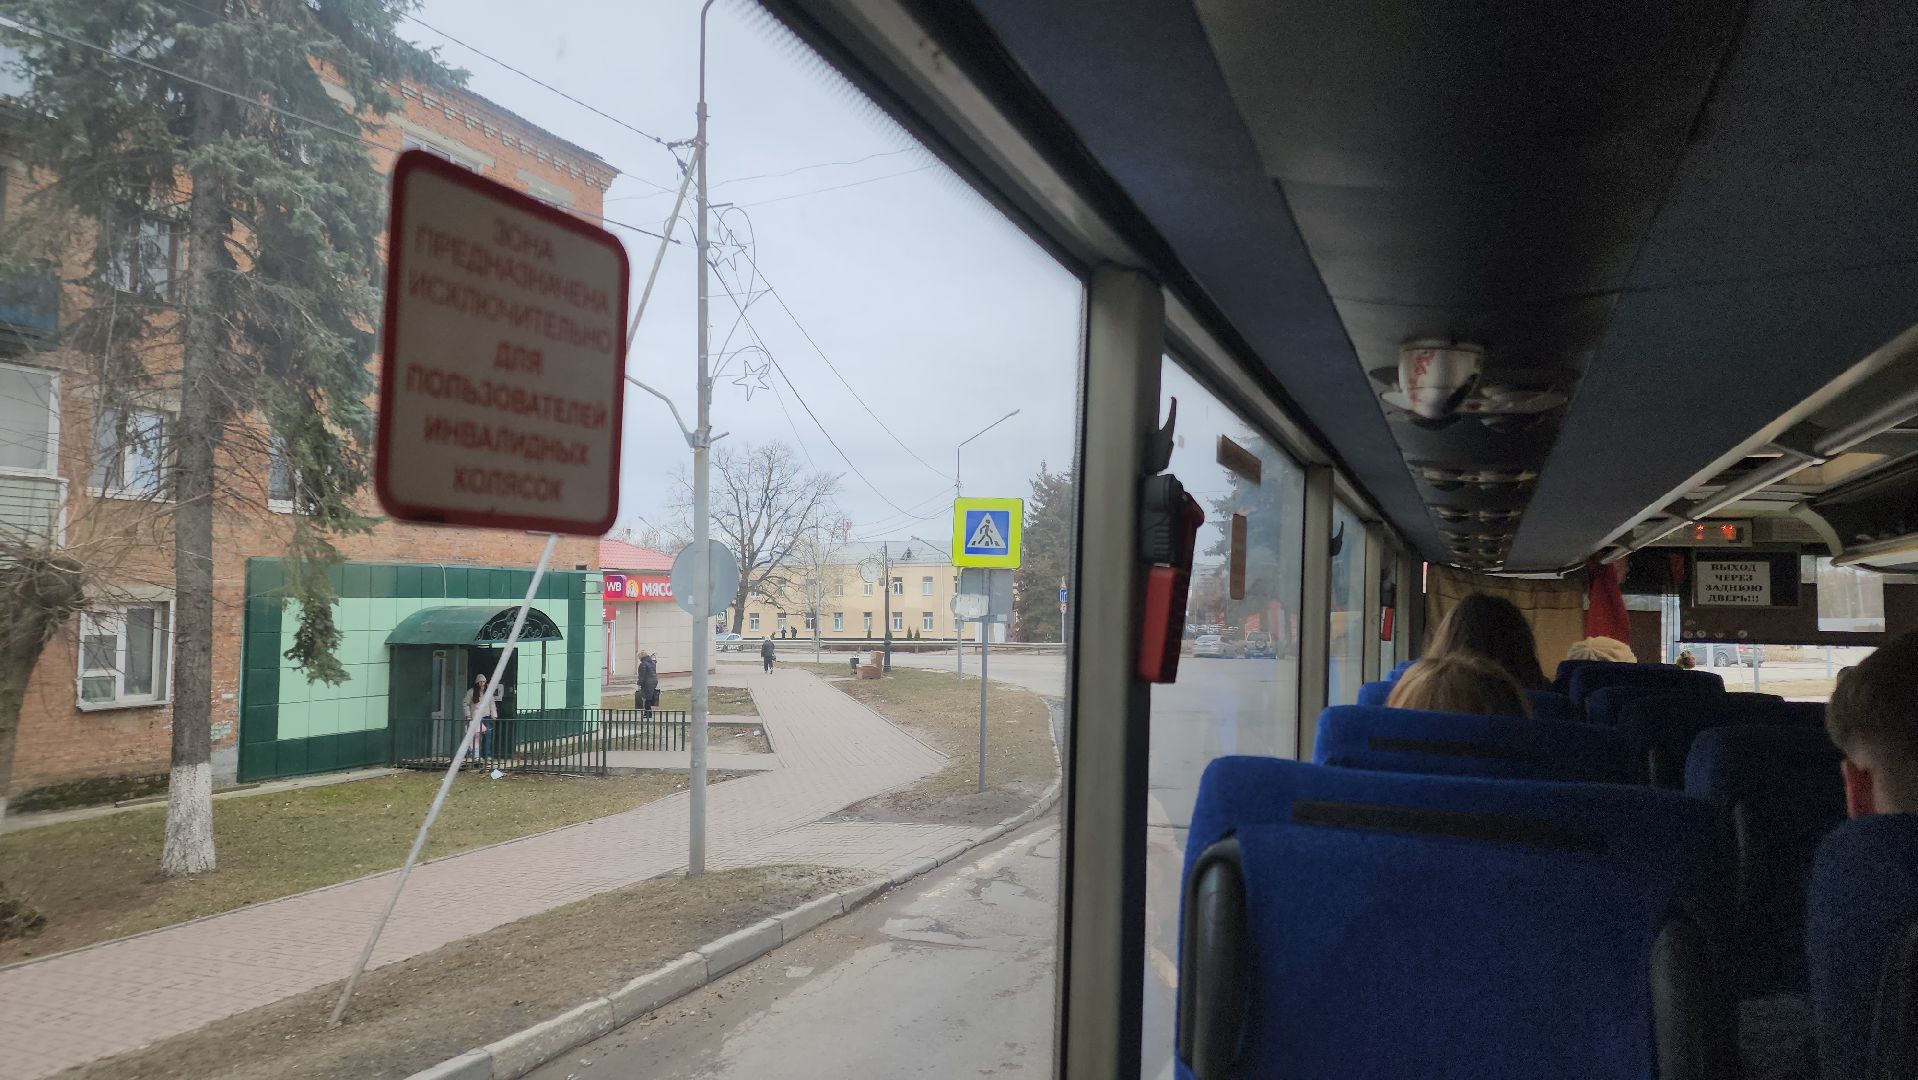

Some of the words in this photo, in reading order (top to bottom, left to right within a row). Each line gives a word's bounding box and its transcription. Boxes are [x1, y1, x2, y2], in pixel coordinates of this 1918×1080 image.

[493, 217, 554, 263] ЗОНА
[415, 223, 610, 314] ПРЕДНАЗНАЧЕНА
[409, 269, 611, 353] ИСКЛЮЧИТЕЛЬНО
[495, 340, 543, 375] ДЛЯ
[406, 362, 607, 430] ПОЛЬЗОВАТЕЛЕЙ
[424, 414, 589, 467] ИНВАЛИДНЫХ
[452, 465, 563, 503] КОЛЯСОК
[606, 581, 622, 591] WB
[1711, 563, 1756, 572] ВЫХОД
[1714, 574, 1753, 582] ЧЕРЕЗ
[1705, 584, 1763, 593] ЗАДНЮЮ
